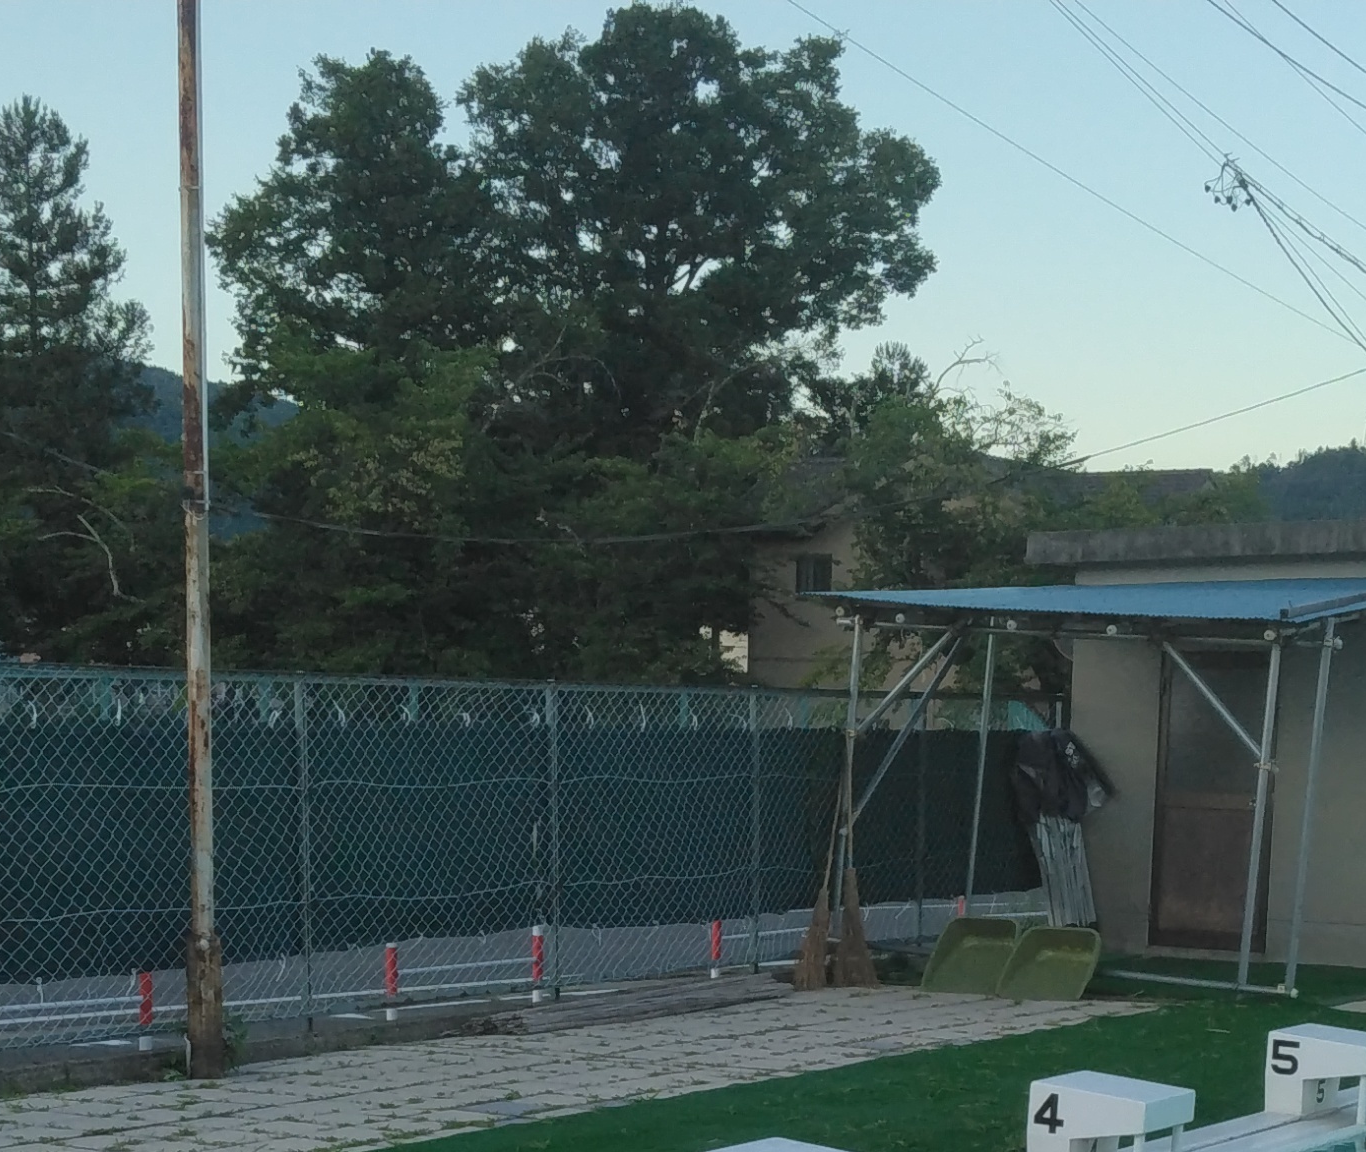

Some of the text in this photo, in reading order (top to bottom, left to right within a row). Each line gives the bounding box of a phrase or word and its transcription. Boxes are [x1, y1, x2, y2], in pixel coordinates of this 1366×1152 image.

[1271, 1039, 1300, 1075] 5
[1316, 1079, 1326, 1103] 5
[1034, 1093, 1064, 1134] 4
